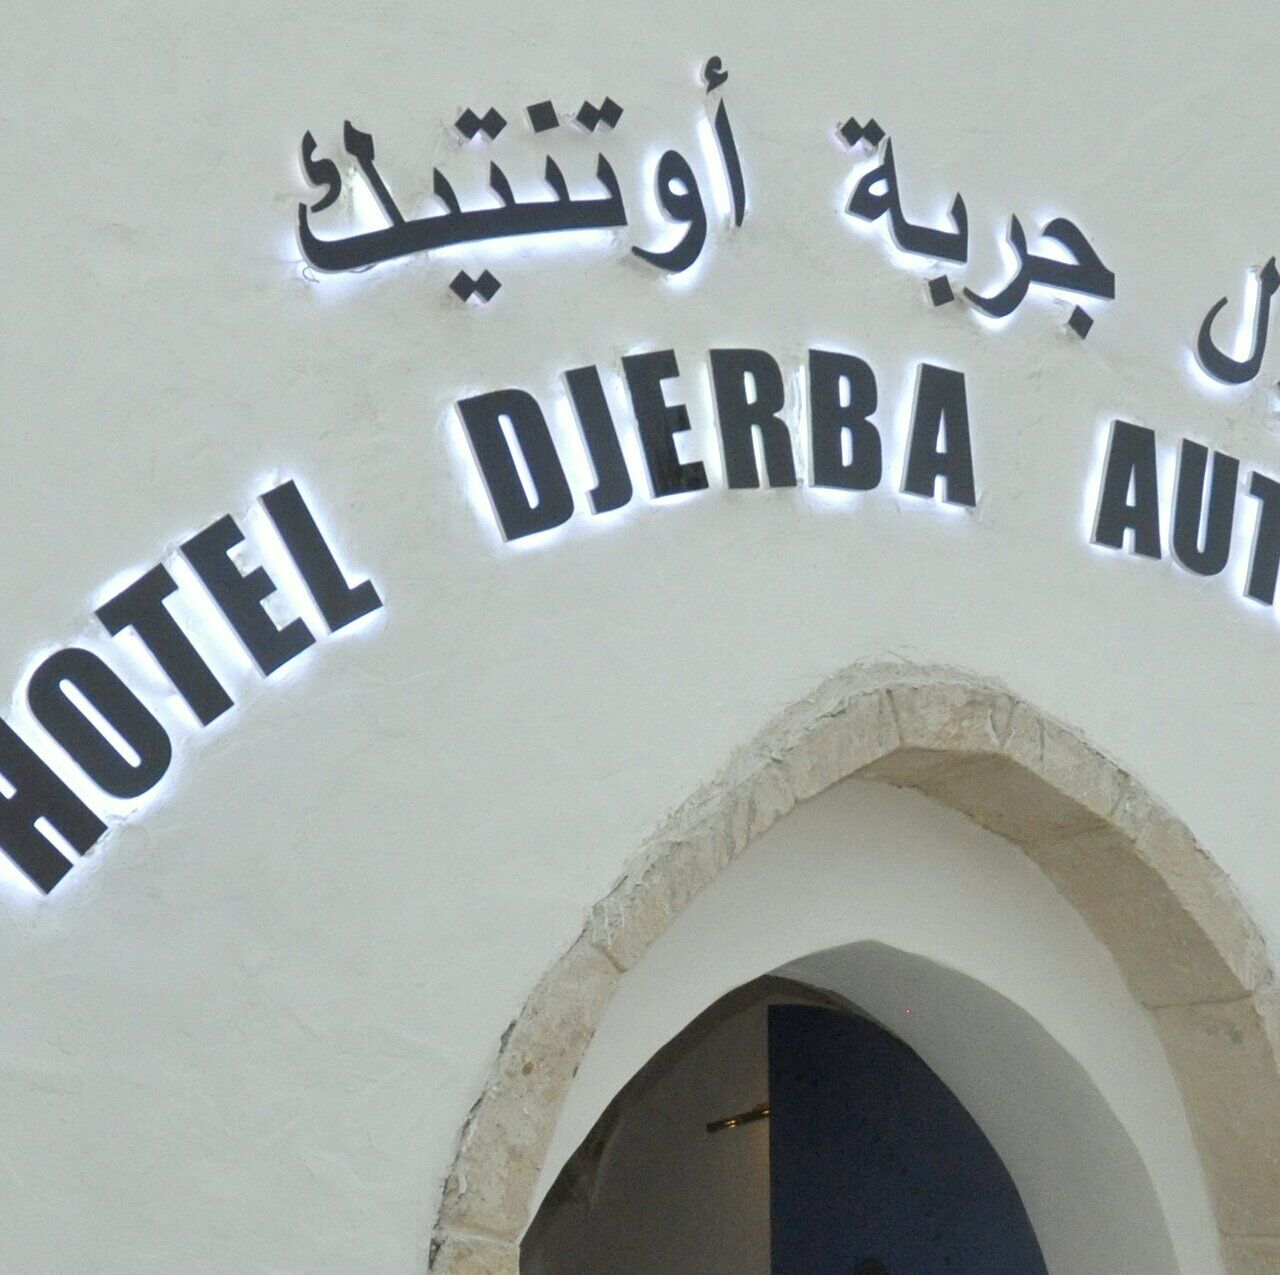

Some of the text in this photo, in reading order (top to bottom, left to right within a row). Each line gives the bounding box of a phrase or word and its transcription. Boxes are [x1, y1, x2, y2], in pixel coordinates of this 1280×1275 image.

[296, 56, 746, 303] أوتنتيك
[837, 117, 1115, 340] جربة
[456, 348, 977, 542] DJERBA
